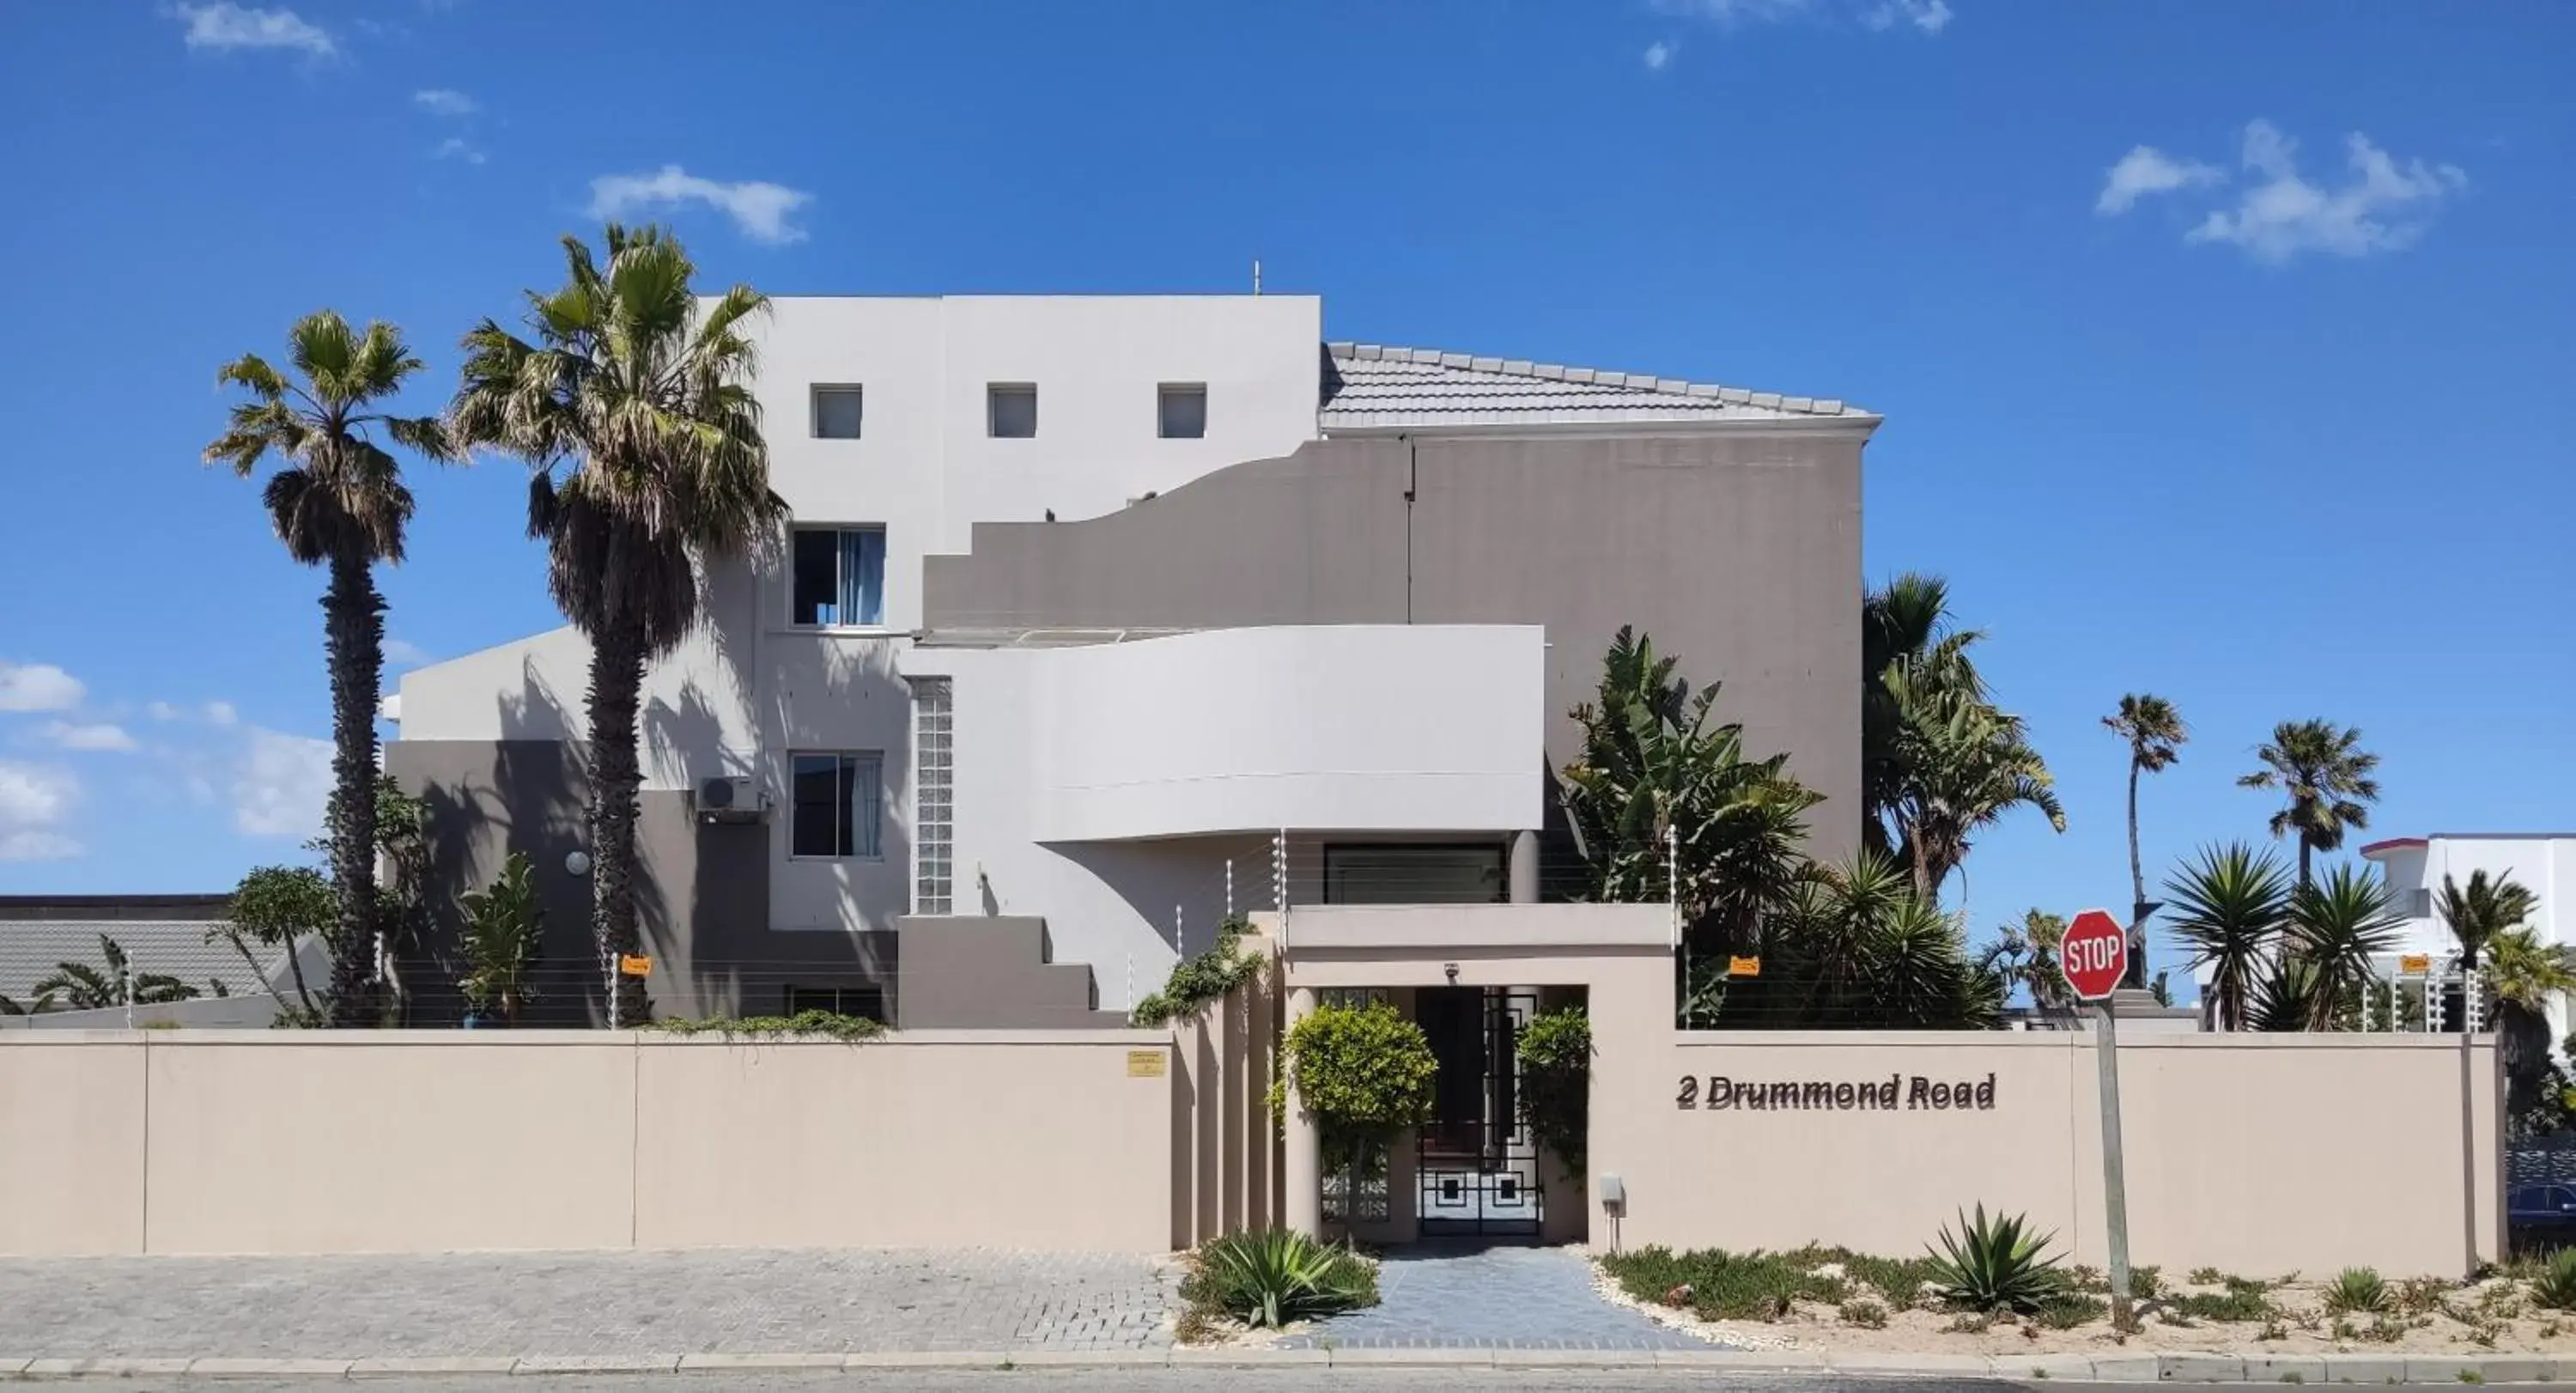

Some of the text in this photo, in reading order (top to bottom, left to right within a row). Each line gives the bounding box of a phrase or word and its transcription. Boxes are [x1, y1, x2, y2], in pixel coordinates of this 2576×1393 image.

[2068, 934, 2120, 973] STOP
[1675, 1072, 1996, 1107] 2 Drummond Road
